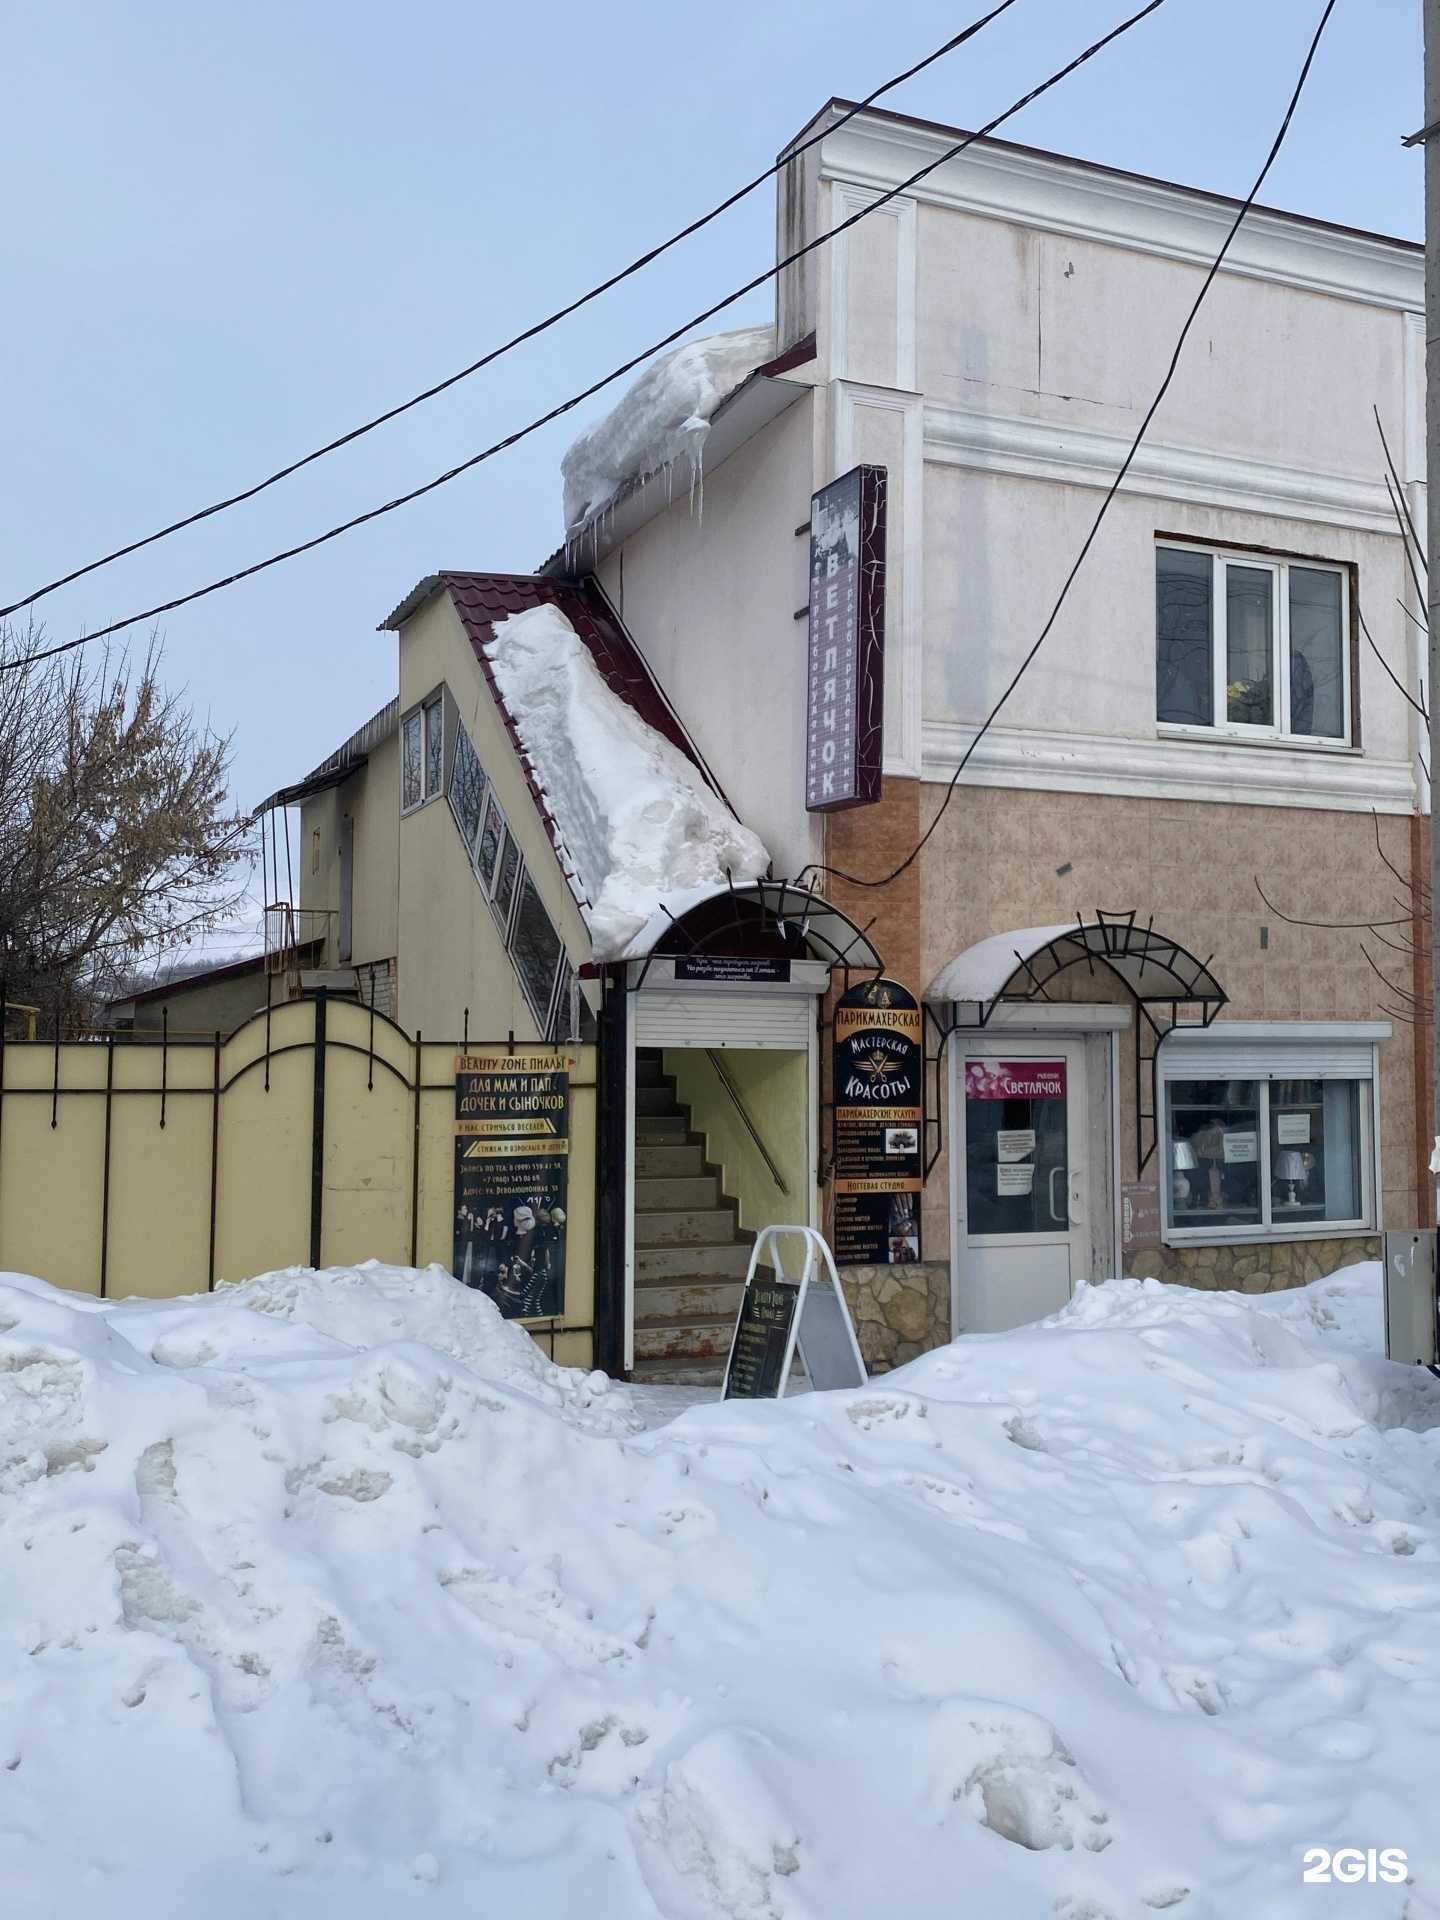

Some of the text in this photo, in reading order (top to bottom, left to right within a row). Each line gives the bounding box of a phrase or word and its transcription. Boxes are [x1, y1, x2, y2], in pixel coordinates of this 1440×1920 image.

[838, 1011, 920, 1027] ПАРИКМАХЕРСКАЯ
[461, 1056, 498, 1071] BEAUTY
[501, 1057, 527, 1071] ZONE
[470, 1077, 491, 1093] ДЛЯ
[494, 1077, 518, 1092] МАМ
[520, 1077, 528, 1092] И
[460, 1095, 564, 1113] ДОЧЕК И СЫНОЧКОВ
